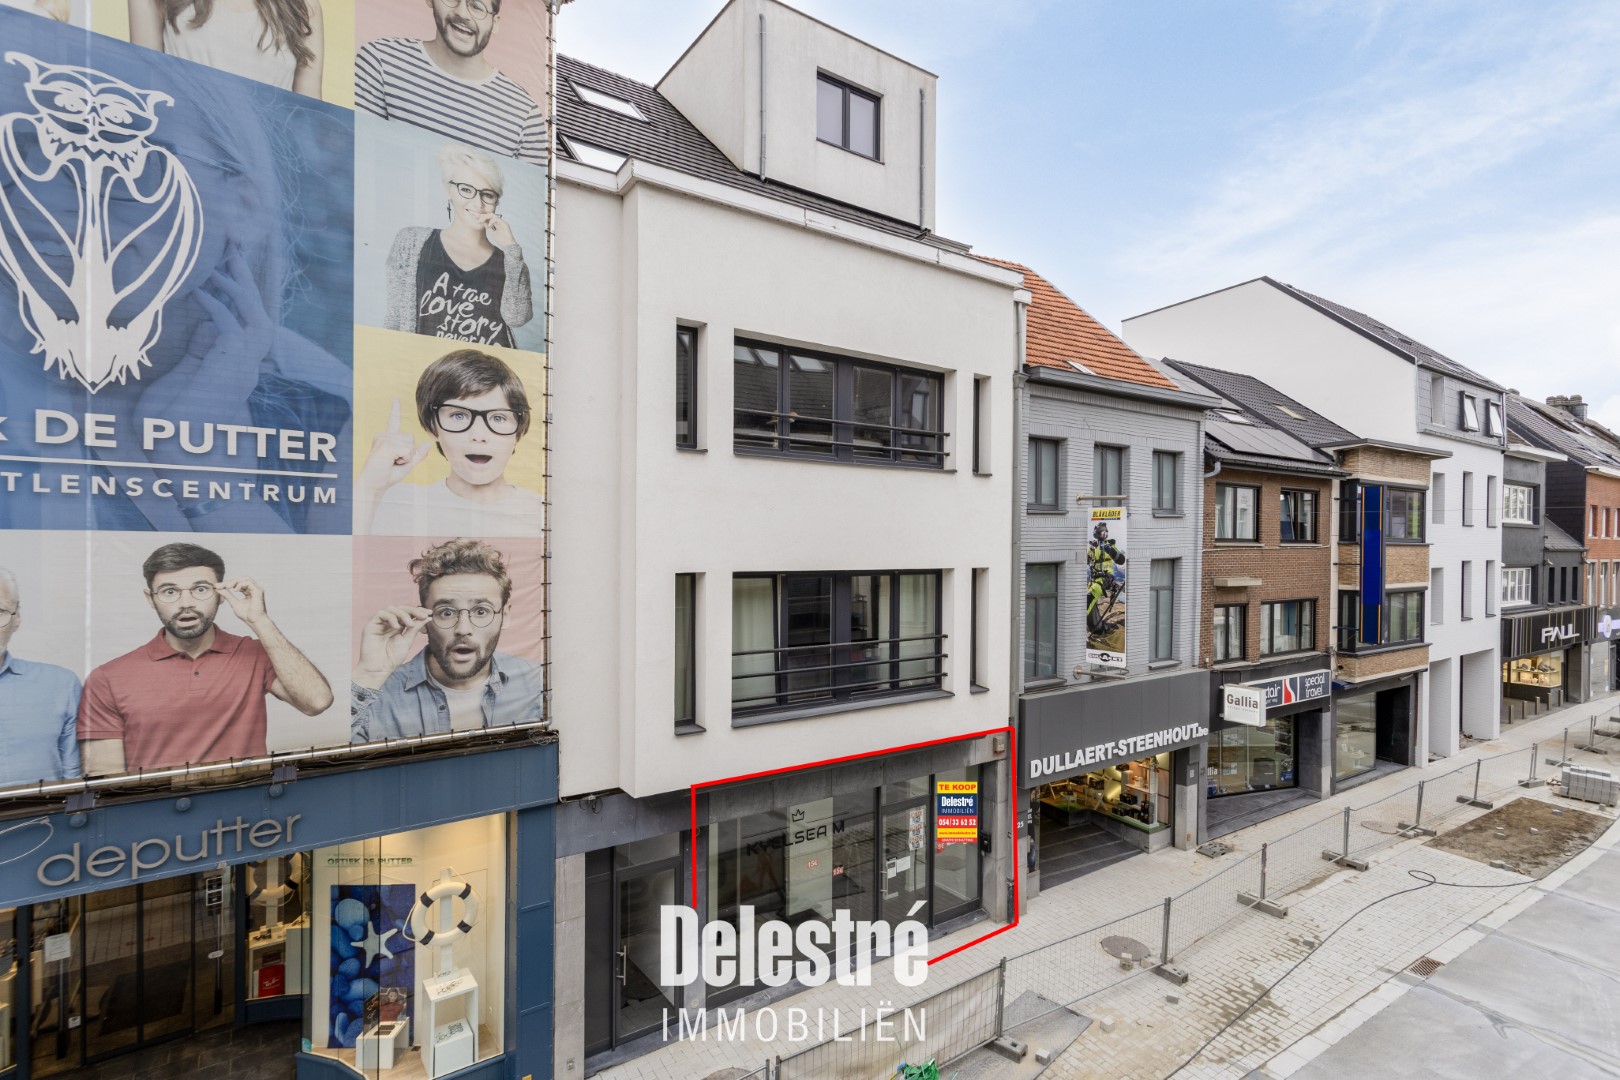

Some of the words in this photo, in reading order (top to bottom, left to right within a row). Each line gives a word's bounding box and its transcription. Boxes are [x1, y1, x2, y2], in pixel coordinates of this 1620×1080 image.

[433, 272, 449, 296] A
[452, 283, 492, 305] true
[420, 290, 474, 317] love
[437, 313, 503, 345] story
[35, 409, 117, 447] DE
[143, 417, 337, 462] PUTTER
[1305, 673, 1325, 689] special
[1305, 684, 1323, 698] travel
[1227, 694, 1258, 709] Gallia
[941, 796, 974, 807] Delestré
[37, 814, 302, 886] deputter
[327, 857, 361, 865] OPTIEK
[364, 857, 375, 865] DE
[378, 857, 413, 865] PUTTER
